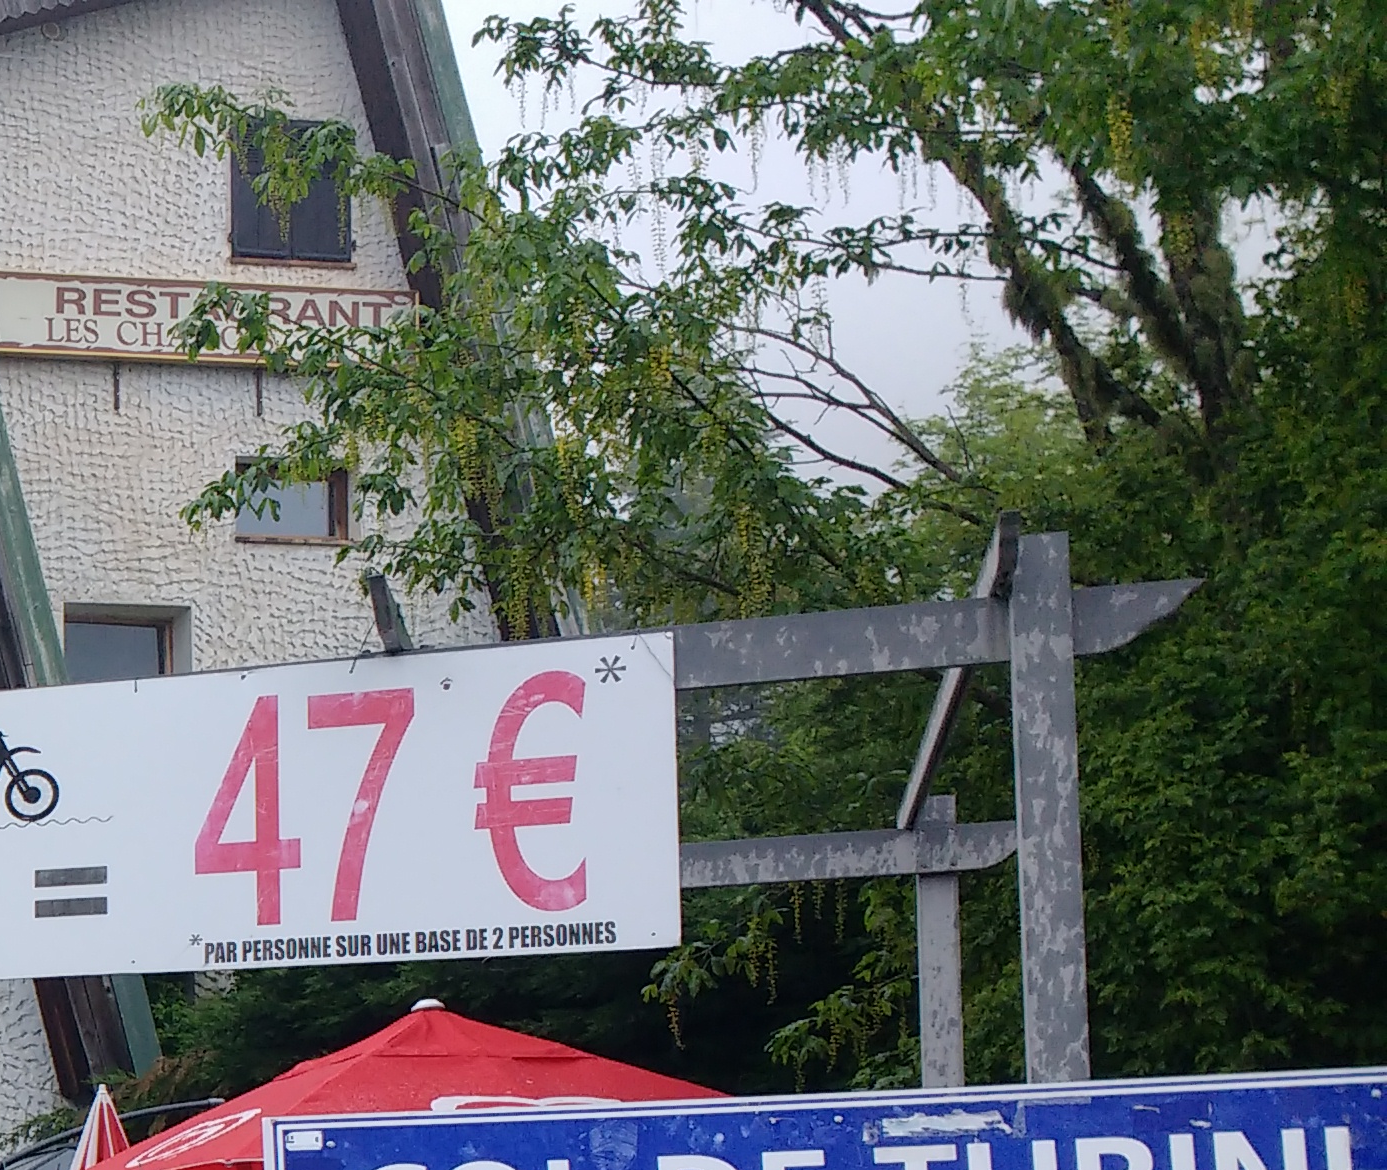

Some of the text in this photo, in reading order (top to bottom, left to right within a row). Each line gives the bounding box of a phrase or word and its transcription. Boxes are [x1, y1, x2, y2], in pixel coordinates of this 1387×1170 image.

[46, 317, 99, 344] LES
[195, 687, 415, 926] 47
[242, 936, 332, 962] PERSONNE
[335, 934, 372, 958] SUR
[377, 932, 411, 956] UNE
[415, 929, 462, 954] BASE
[466, 928, 488, 951] DE
[492, 927, 504, 950] 2
[508, 921, 617, 949] PERSONNES
